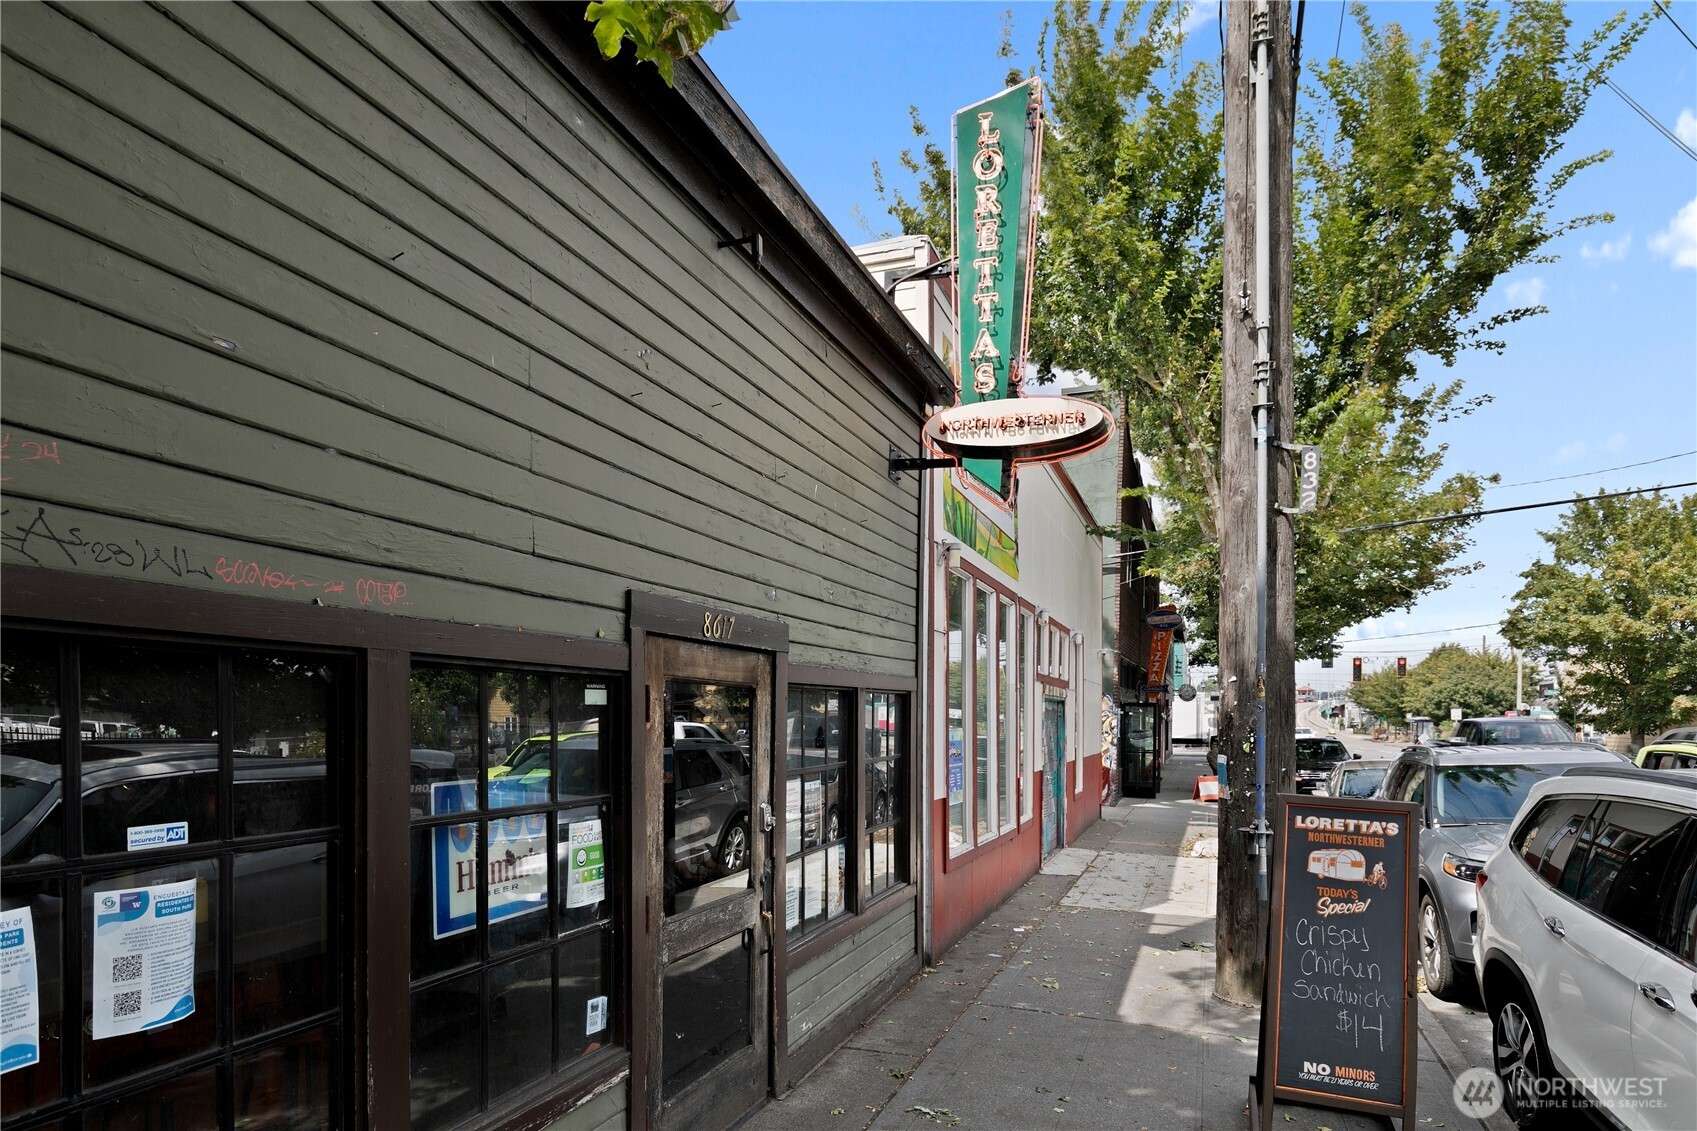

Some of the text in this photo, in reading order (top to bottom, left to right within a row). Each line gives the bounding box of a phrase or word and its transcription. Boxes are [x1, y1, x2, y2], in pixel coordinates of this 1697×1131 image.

[940, 410, 1086, 434] NORTHWESTERNER
[1302, 451, 1318, 509] 832
[703, 611, 736, 640] 8617
[1149, 631, 1166, 682] PIZZA
[167, 828, 185, 840] ADT
[1295, 815, 1400, 837] LORETTA'S
[130, 835, 157, 844] secured
[572, 832, 594, 845] FOOD
[1308, 832, 1385, 848] NORTHWESTERNER
[153, 890, 184, 901] ENCUESTA
[1317, 886, 1358, 899] TODAY'S
[161, 906, 181, 914] SOUTH
[1316, 897, 1371, 918] Special
[13, 918, 23, 926] OF
[4, 930, 20, 939] PARK
[1295, 918, 1370, 952] Crispy
[1301, 949, 1381, 982] Chicken
[1292, 979, 1391, 1009] Sandwich
[1336, 1008, 1384, 1053] $14
[1298, 1072, 1309, 1080] YOU
[1335, 1077, 1354, 1087] YEARS
[1354, 1080, 1363, 1088] OR
[1363, 1081, 1379, 1090] OVER
[1303, 1061, 1376, 1082] NO MINORS
